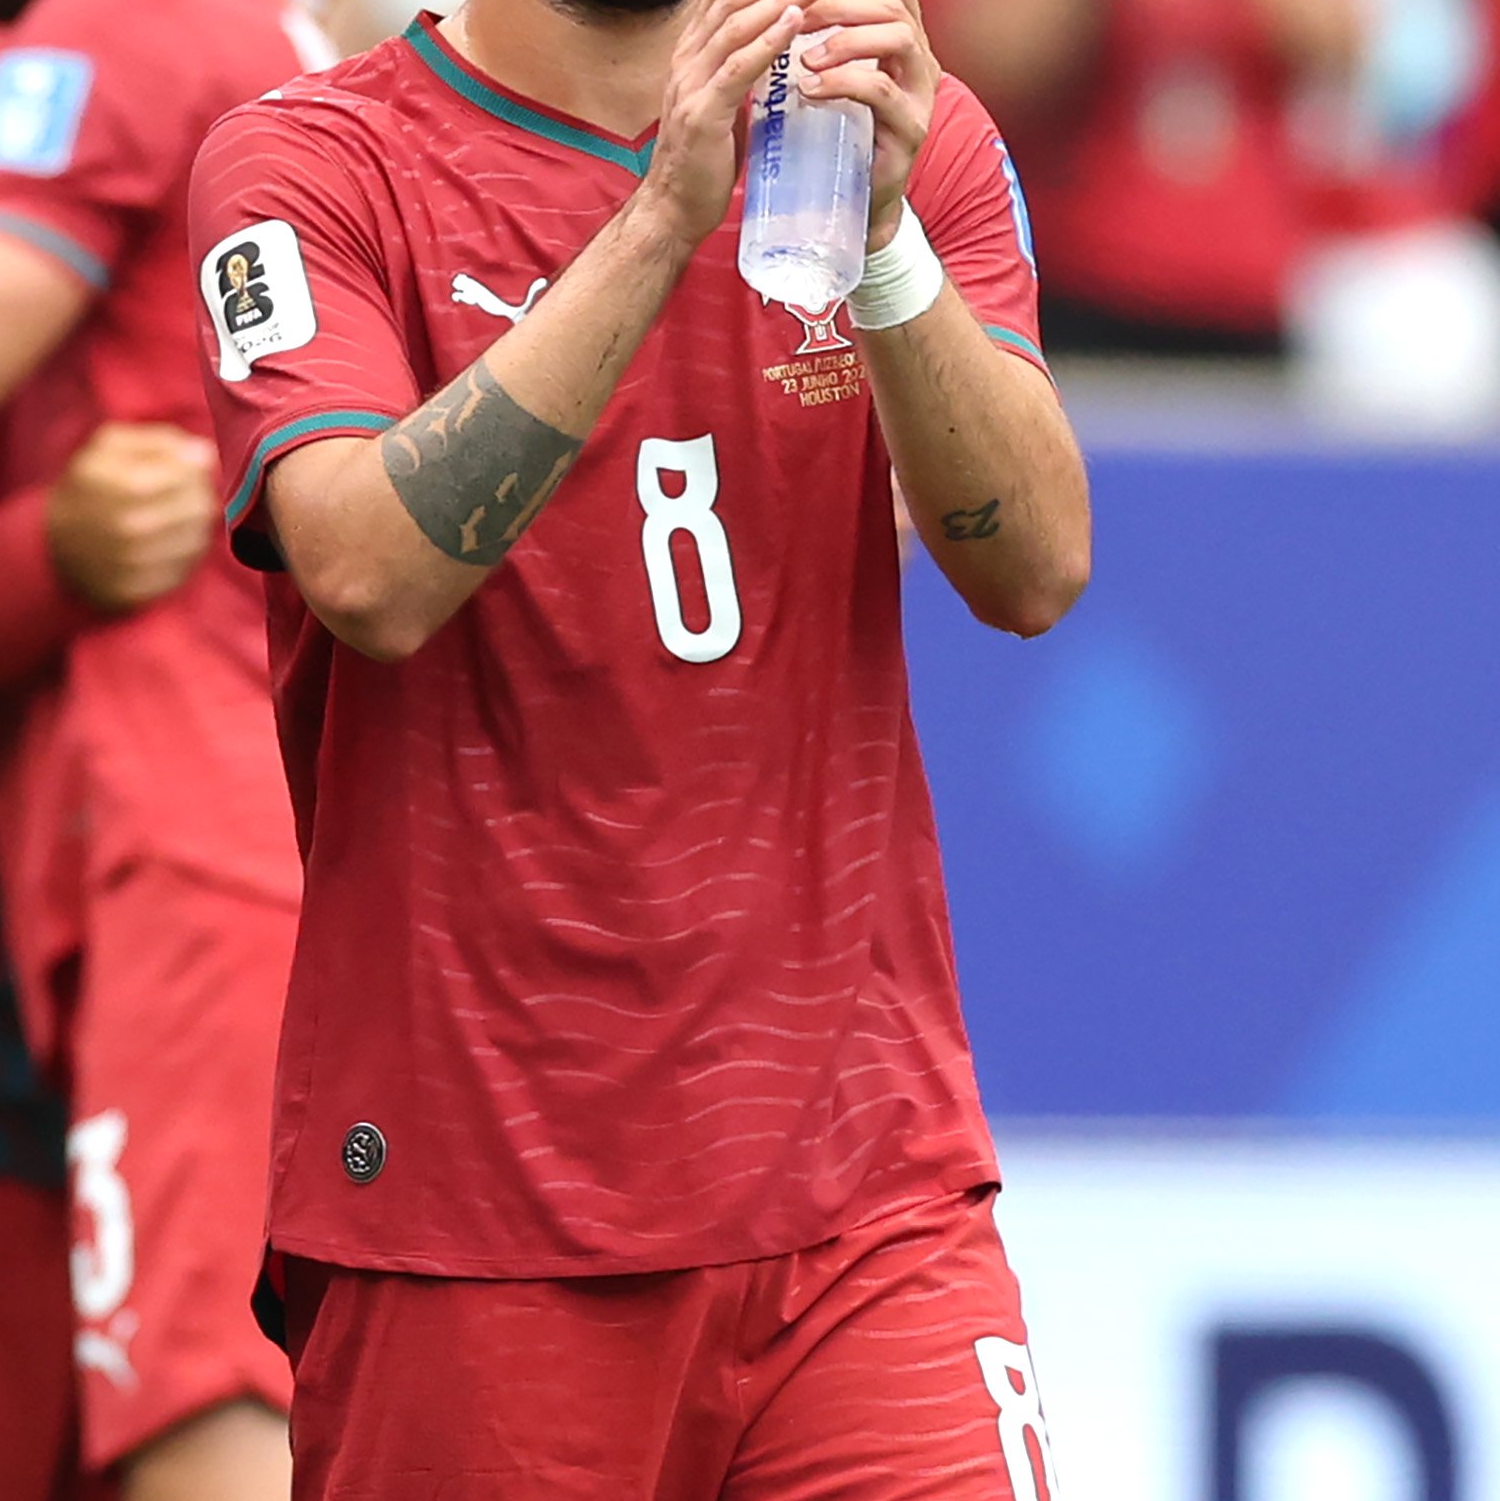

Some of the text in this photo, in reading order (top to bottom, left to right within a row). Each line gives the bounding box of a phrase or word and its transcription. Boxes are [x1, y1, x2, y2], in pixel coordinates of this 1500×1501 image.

[761, 52, 791, 181] smartwa
[781, 365, 867, 395] 23 JUNHO 202
[800, 382, 860, 407] HOUSTON
[635, 432, 743, 664] 8
